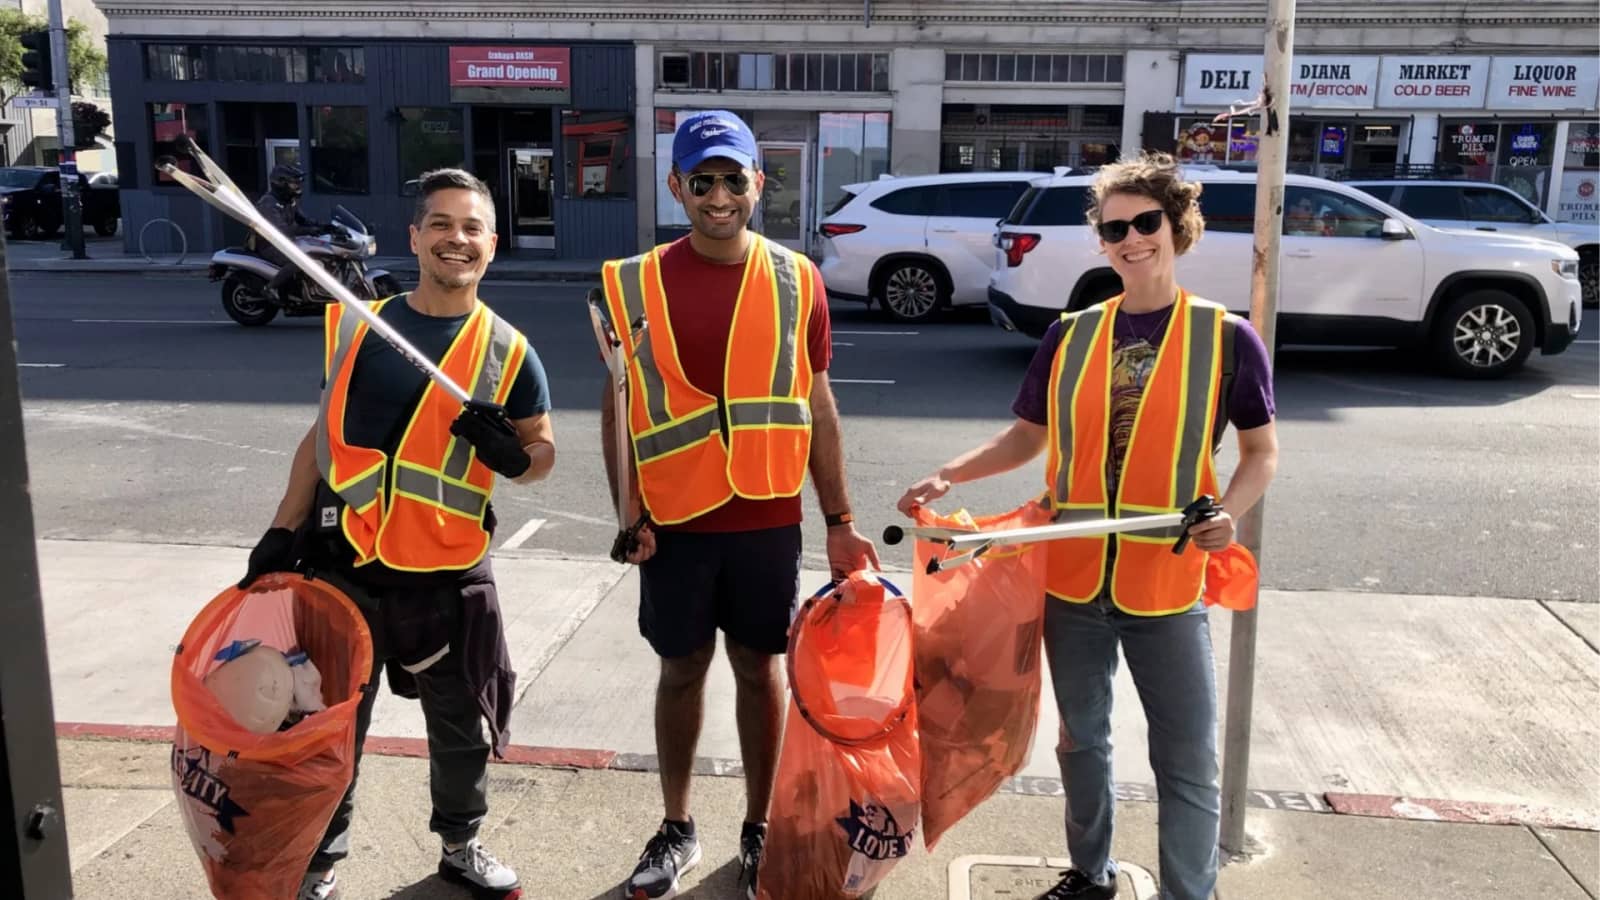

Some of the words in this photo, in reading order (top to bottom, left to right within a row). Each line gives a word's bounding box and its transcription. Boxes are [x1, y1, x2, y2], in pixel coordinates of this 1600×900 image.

[468, 64, 504, 78] Grand
[507, 64, 557, 81] Opening
[1300, 64, 1351, 79] DIANA
[1399, 64, 1471, 80] MARKET
[1513, 65, 1577, 83] LIQUOR
[1200, 70, 1251, 89] DELI
[1290, 83, 1367, 97] TM/BITCOIN
[1394, 84, 1431, 96] COLD
[1435, 85, 1471, 96] BEER
[1508, 85, 1538, 97] FINE
[1543, 85, 1576, 97] WINE
[1451, 135, 1495, 144] TRUMER
[1462, 143, 1484, 151] PILS
[1509, 156, 1537, 167] OPEN
[1560, 203, 1600, 211] TRUME
[1572, 213, 1595, 221] PILS
[852, 828, 898, 858] LOVE
